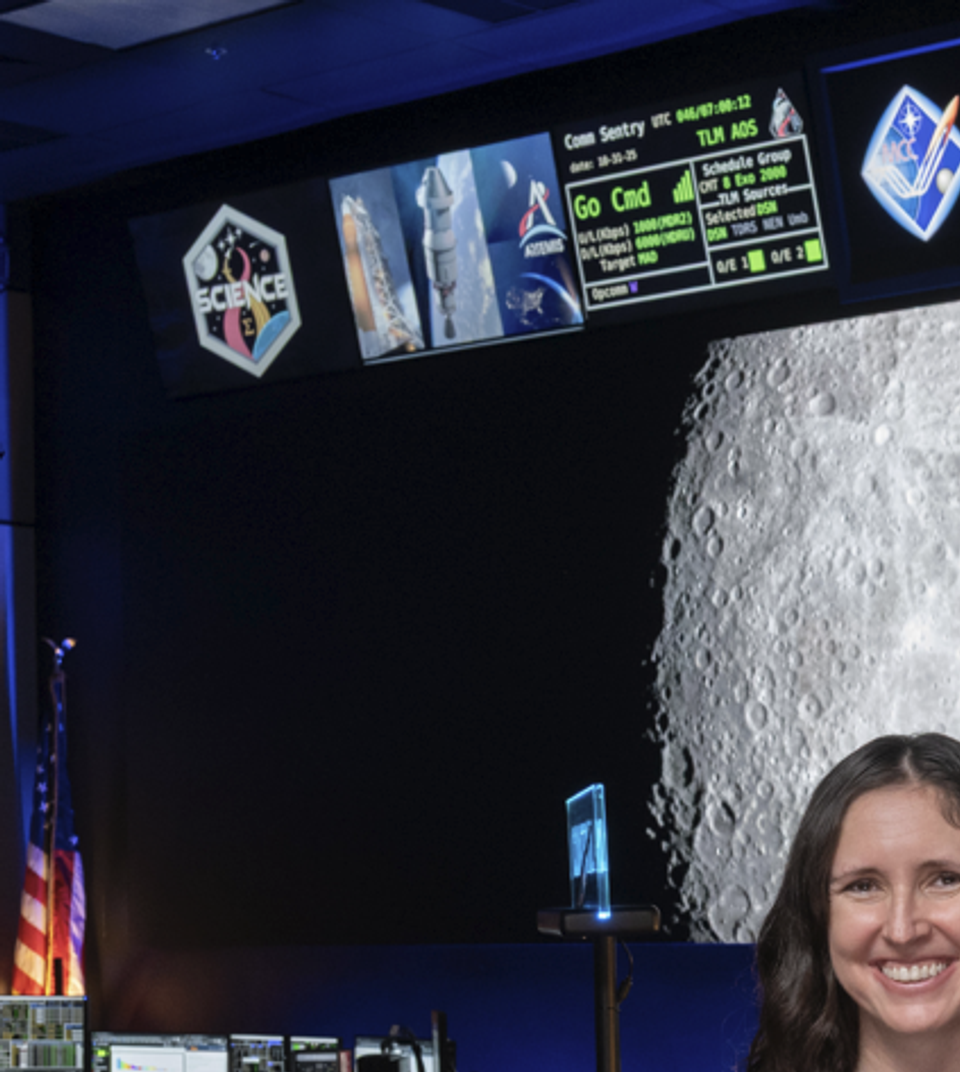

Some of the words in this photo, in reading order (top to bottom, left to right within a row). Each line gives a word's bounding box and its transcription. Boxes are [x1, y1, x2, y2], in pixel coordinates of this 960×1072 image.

[563, 132, 597, 150] Comm
[599, 120, 646, 143] Sentry
[650, 112, 673, 128] UTC
[696, 126, 725, 147] TLM
[731, 118, 759, 140] AOS
[702, 155, 755, 178] Schedule
[757, 149, 793, 166] Group
[882, 137, 919, 165] MCC
[574, 194, 601, 219] Go
[611, 180, 652, 213] Cmd
[717, 190, 741, 206] TLM
[742, 183, 788, 203] Sources
[704, 204, 757, 227] Selected
[756, 200, 779, 217] DSN
[706, 226, 729, 242] DSN
[599, 254, 637, 273] Target
[196, 273, 289, 314] SCIENCE
